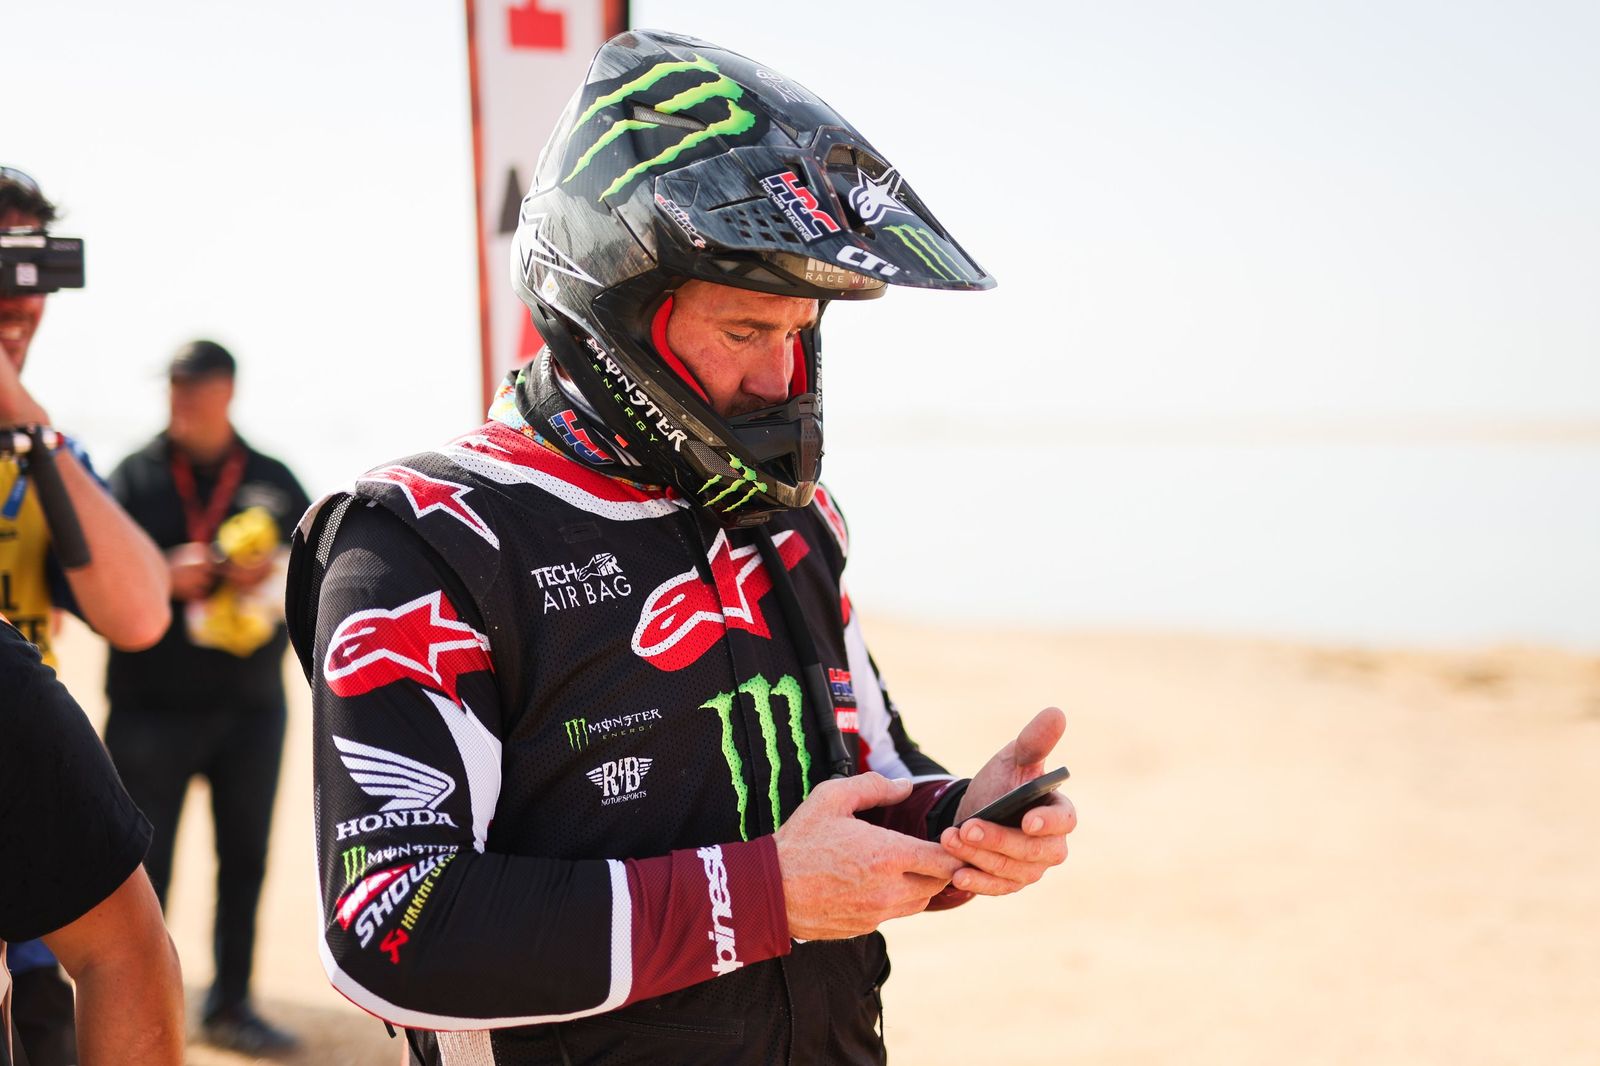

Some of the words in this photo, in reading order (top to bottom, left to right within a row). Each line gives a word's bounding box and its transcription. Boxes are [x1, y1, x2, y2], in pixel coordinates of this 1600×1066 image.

[765, 171, 841, 239] HRC
[783, 209, 812, 242] RACING
[805, 272, 844, 283] RACE
[586, 337, 688, 452] MONSTER
[593, 364, 658, 442] ENERGY
[531, 562, 579, 589] TECH
[587, 708, 662, 734] MONSTER
[602, 723, 653, 740] ENERGY
[336, 809, 459, 841] HONDA
[367, 843, 460, 865] MONSTER
